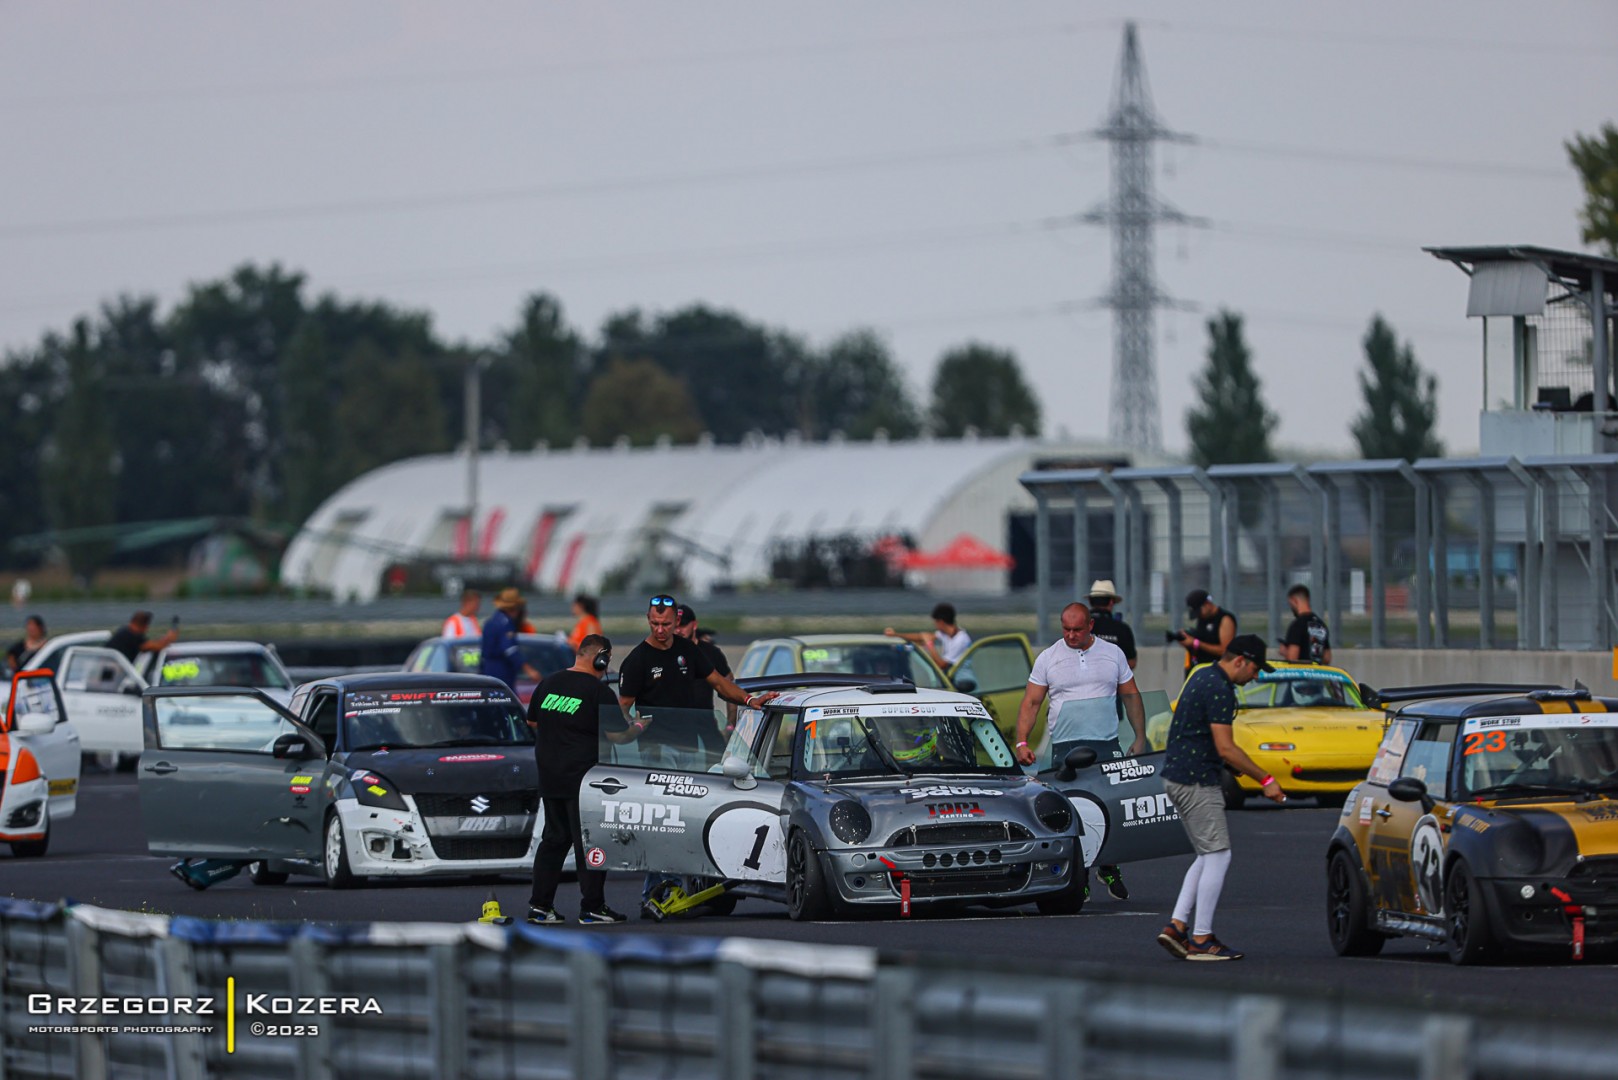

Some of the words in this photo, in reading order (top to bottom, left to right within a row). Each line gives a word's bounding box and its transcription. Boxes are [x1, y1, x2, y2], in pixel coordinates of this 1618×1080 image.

[391, 692, 436, 701] SWIFT
[805, 719, 817, 739] 1
[1480, 719, 1500, 727] WORK
[1502, 718, 1521, 726] STUFF
[1463, 730, 1507, 757] 23
[1121, 764, 1155, 779] SQUAD
[666, 783, 708, 796] SQUAD
[601, 800, 686, 828] TOP1
[925, 801, 985, 816] TOP1
[1120, 793, 1177, 821] TOP
[1138, 815, 1178, 825] KARTING
[618, 823, 667, 833] KARTING
[743, 824, 770, 871] 1
